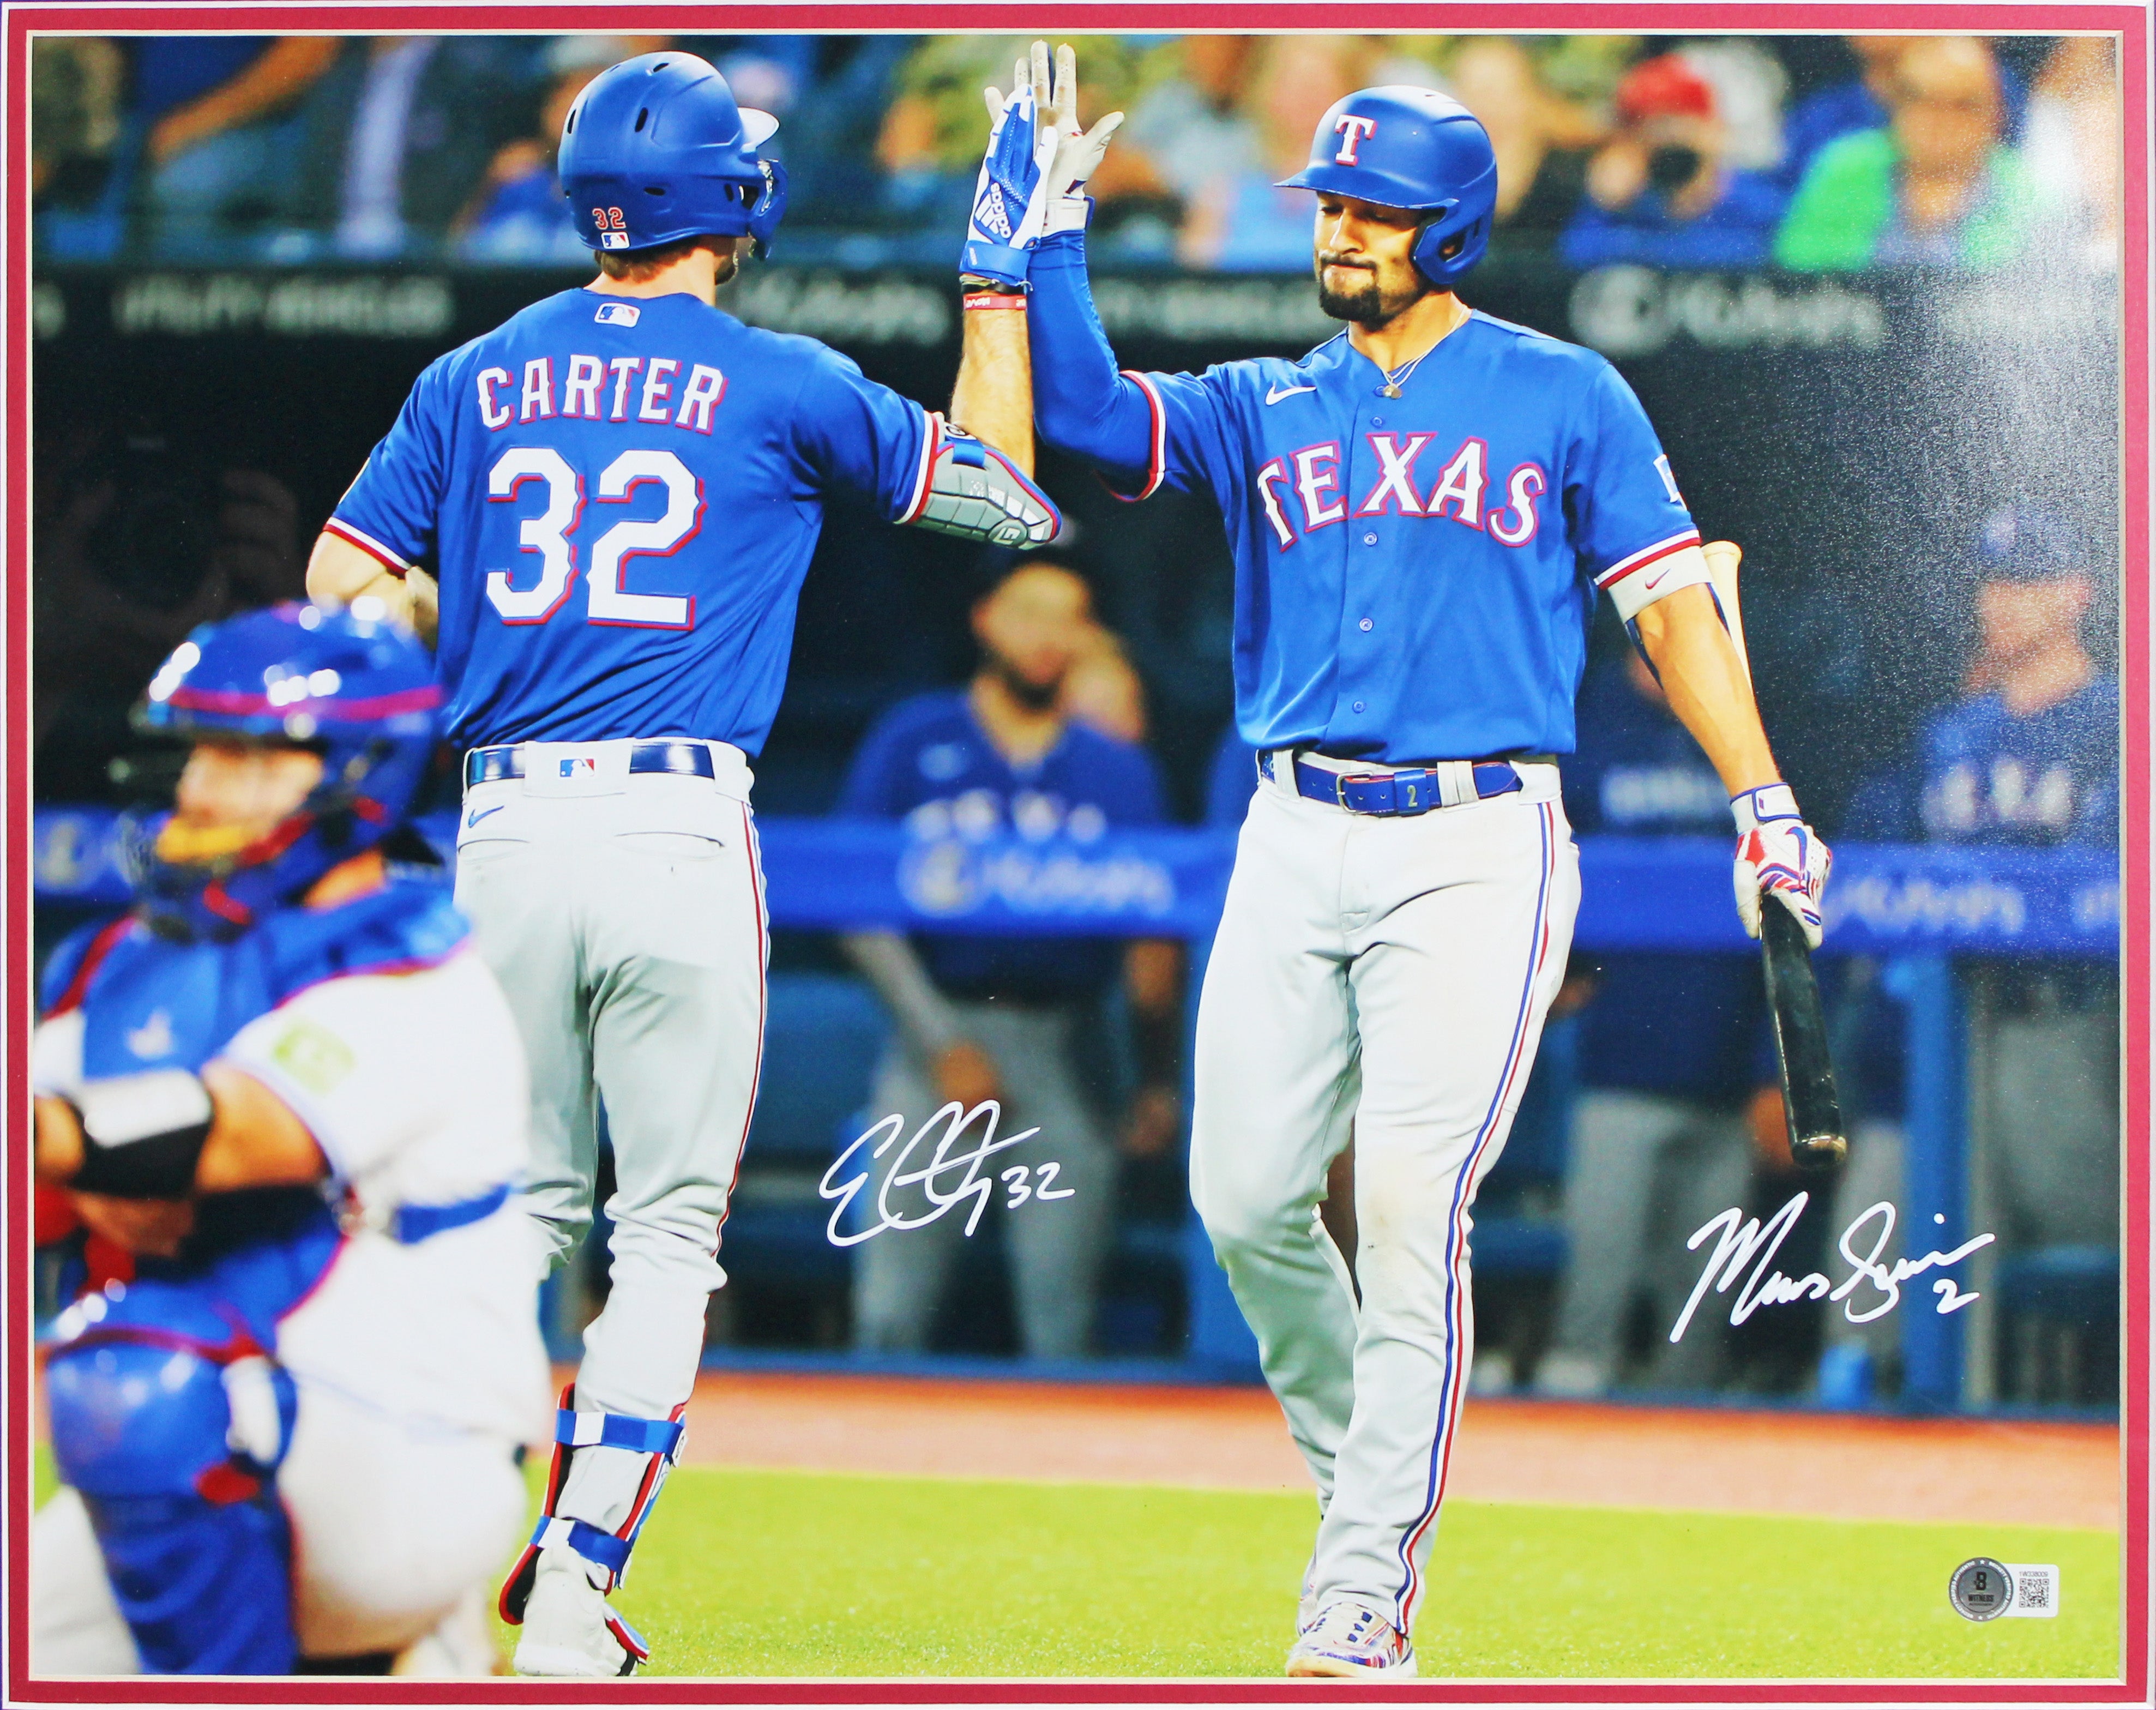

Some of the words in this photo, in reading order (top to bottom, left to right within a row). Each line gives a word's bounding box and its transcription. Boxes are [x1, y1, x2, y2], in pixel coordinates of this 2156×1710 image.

[1335, 114, 1378, 166] T
[592, 207, 627, 230] 32
[990, 182, 1013, 239] adidas
[477, 354, 728, 436] CARTER
[1257, 431, 1547, 553] TEXAS
[485, 447, 708, 631] 32
[1406, 784, 1418, 808] 2
[1001, 1161, 1076, 1209] 32
[1932, 1279, 1980, 1315] 2
[1968, 1594, 1994, 1602] WITNESS
